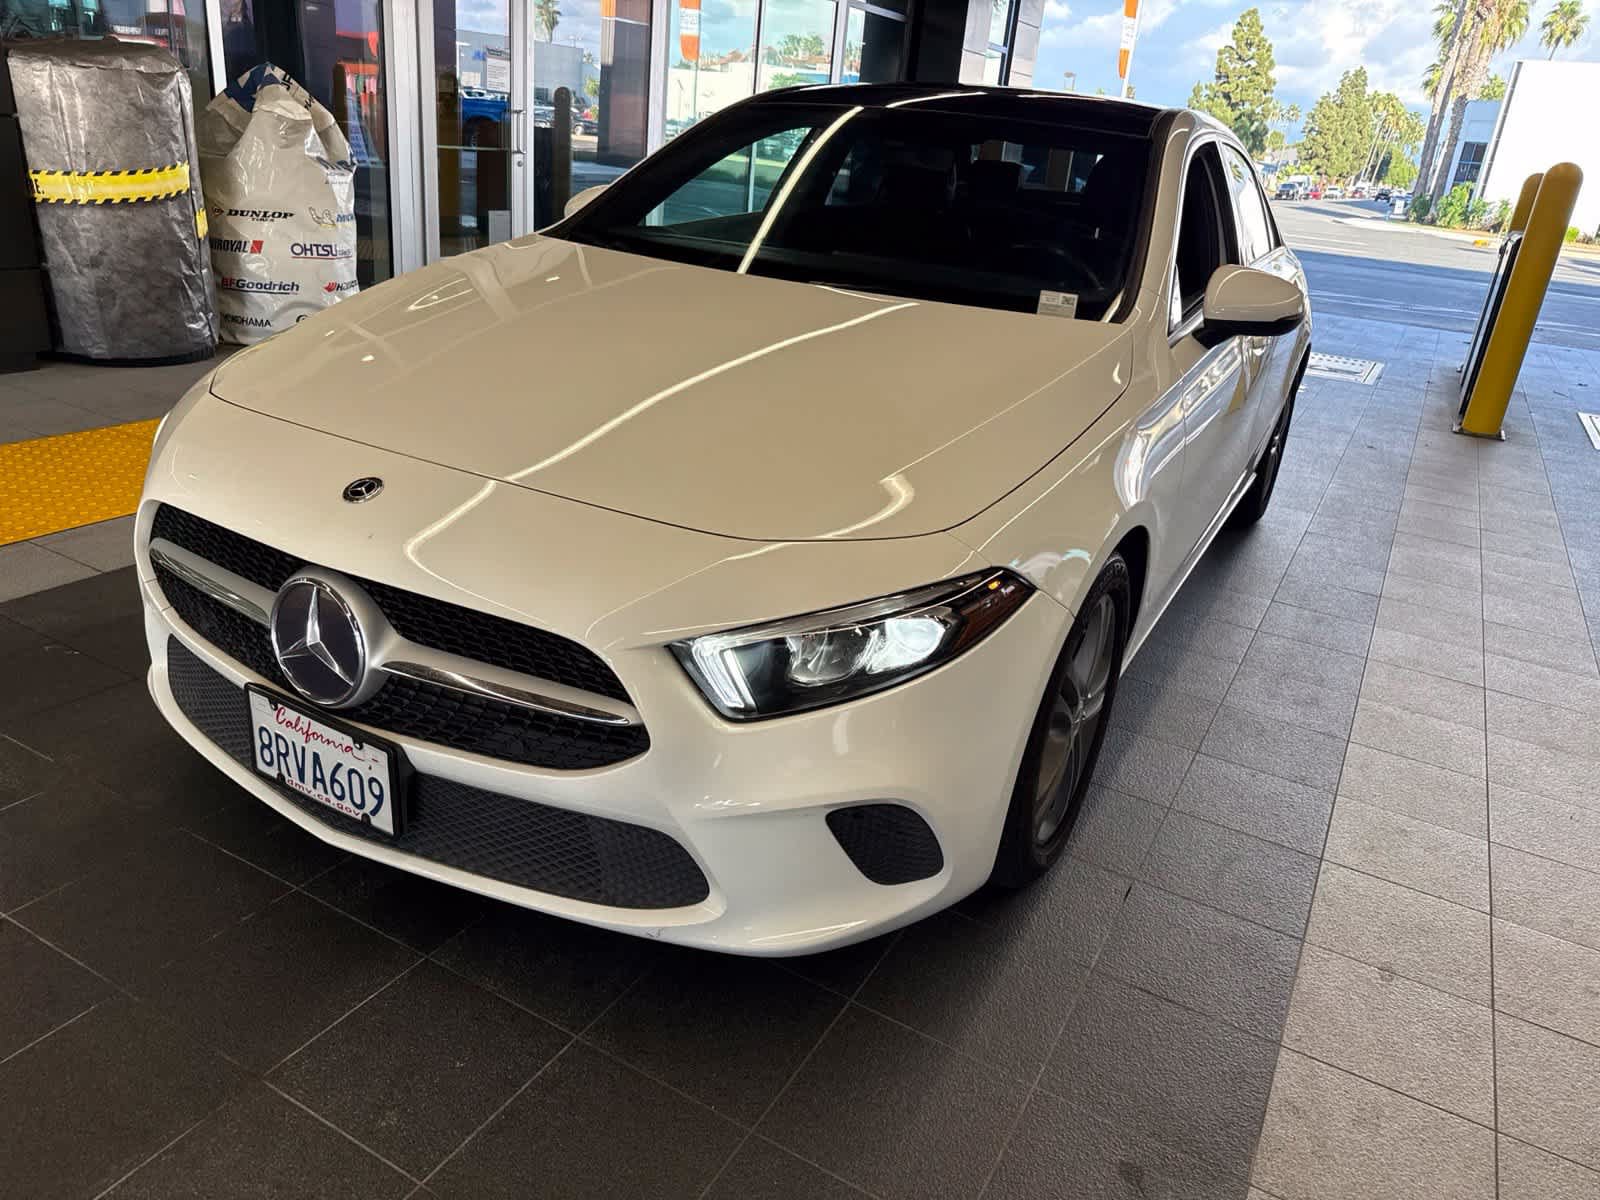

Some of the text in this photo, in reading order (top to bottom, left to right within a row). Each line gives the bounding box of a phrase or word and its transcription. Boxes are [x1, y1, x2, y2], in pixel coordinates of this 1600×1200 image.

[226, 209, 295, 219] DUNLOP
[290, 243, 338, 257] OHTSU
[275, 706, 365, 762] California
[258, 725, 385, 817] 8RVA609
[287, 778, 361, 817] dmv.ca.gov
